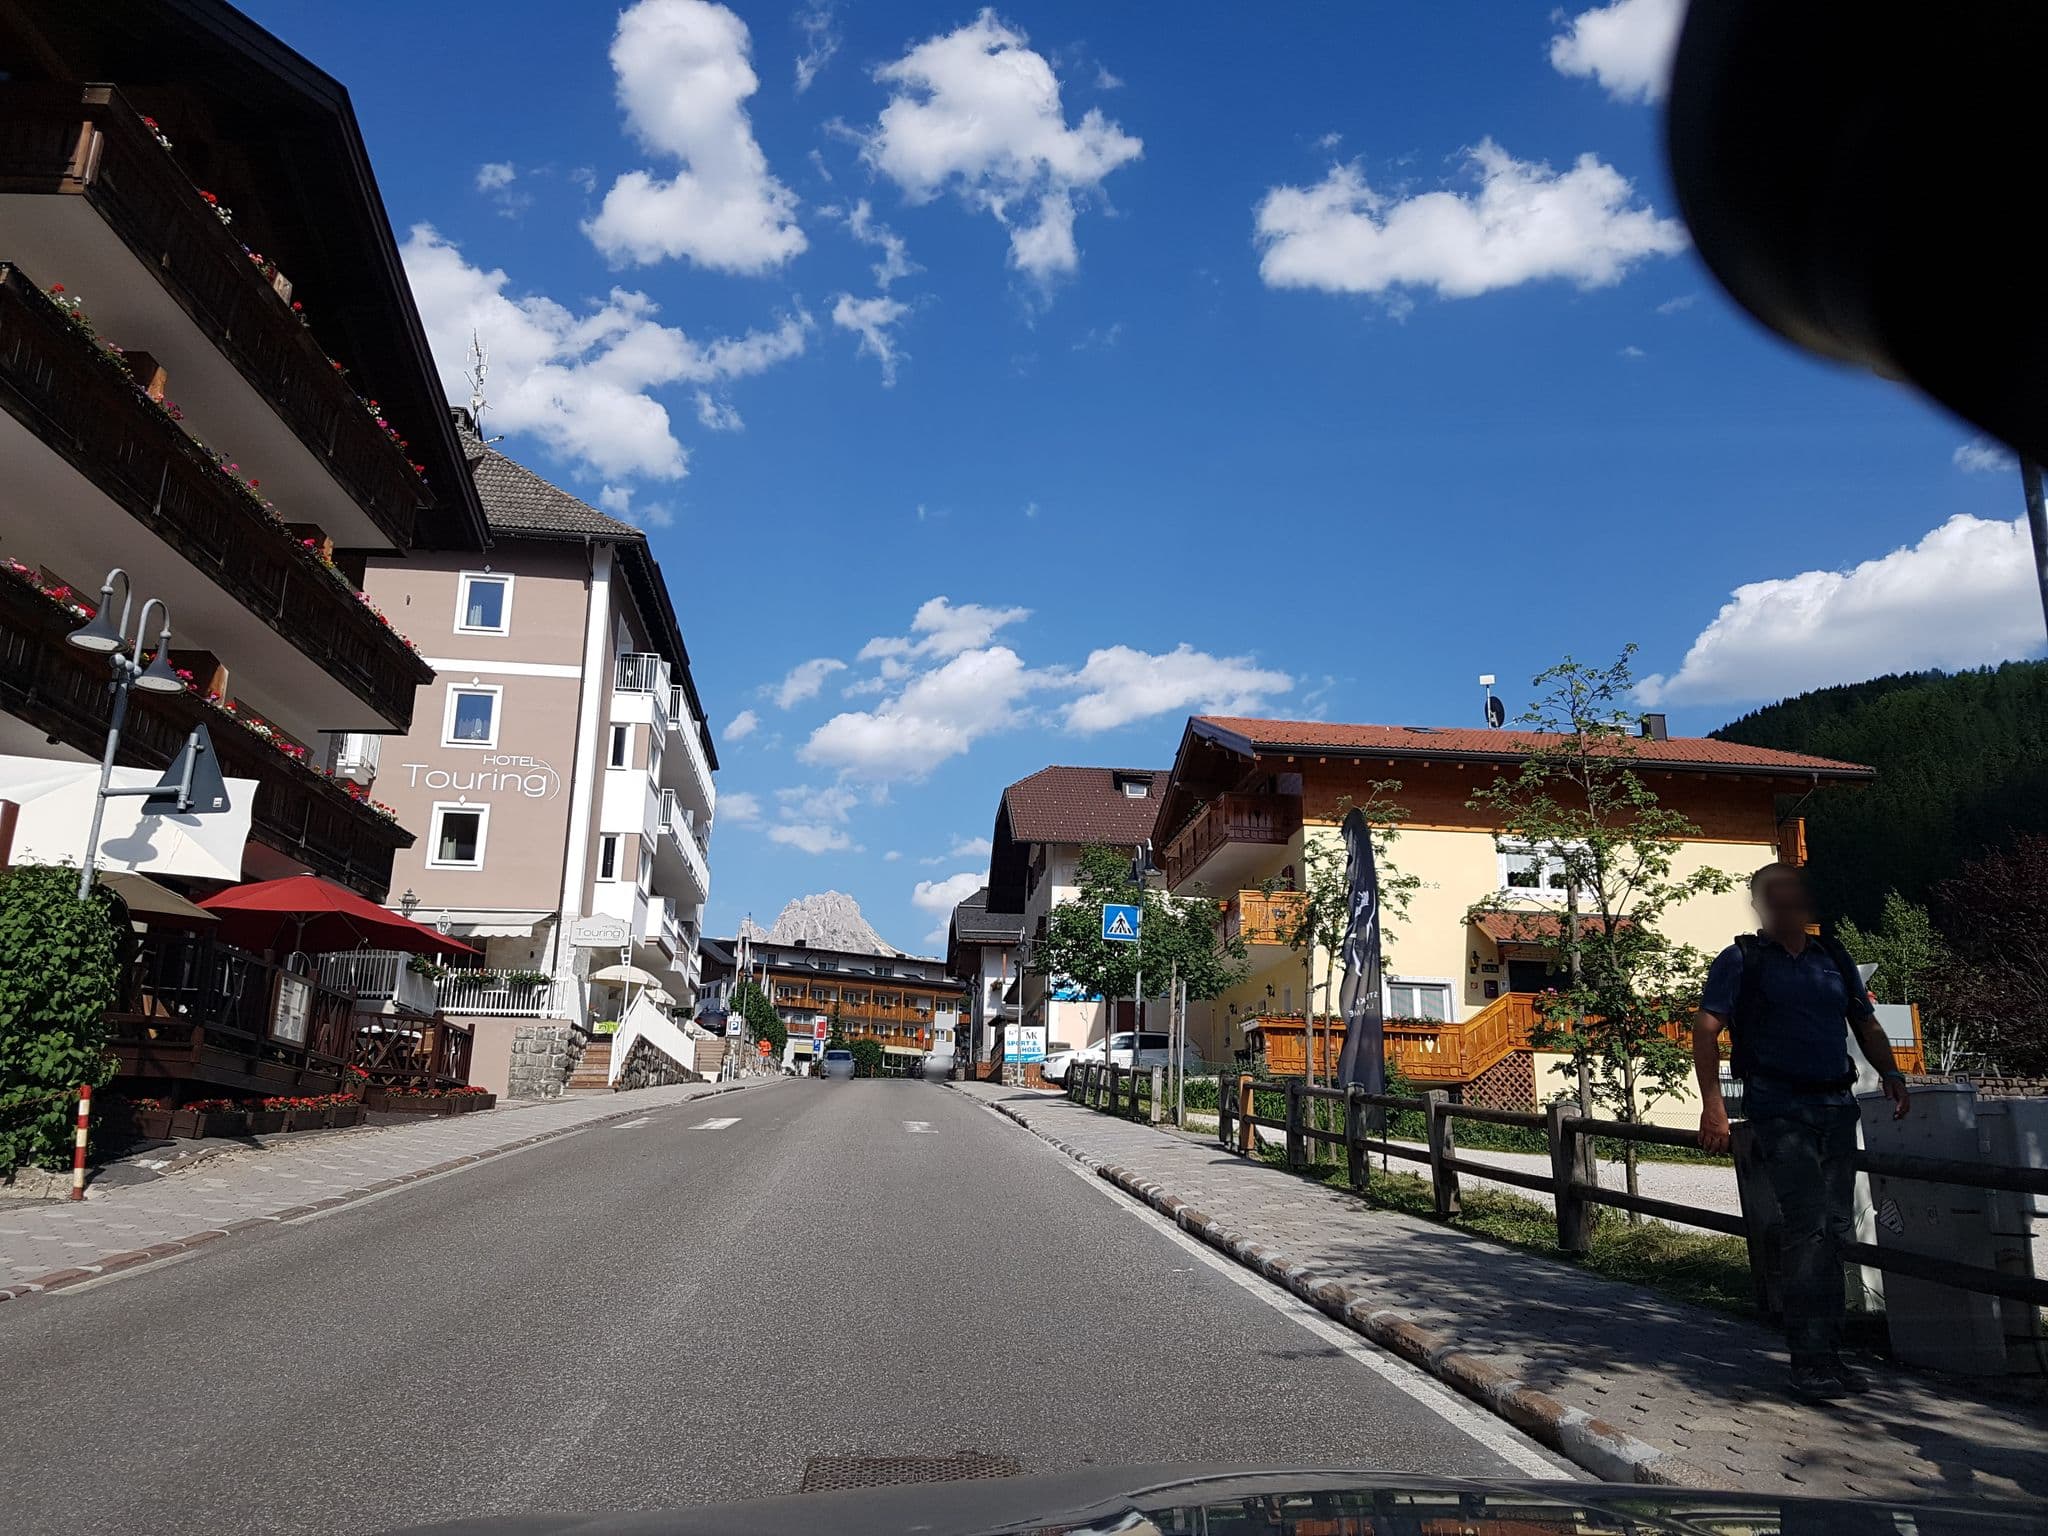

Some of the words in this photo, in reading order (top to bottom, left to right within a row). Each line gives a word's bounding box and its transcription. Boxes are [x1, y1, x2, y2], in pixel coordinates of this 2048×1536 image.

[482, 754, 540, 767] HOTEL
[401, 763, 547, 797] Touring
[576, 927, 621, 938] Touring
